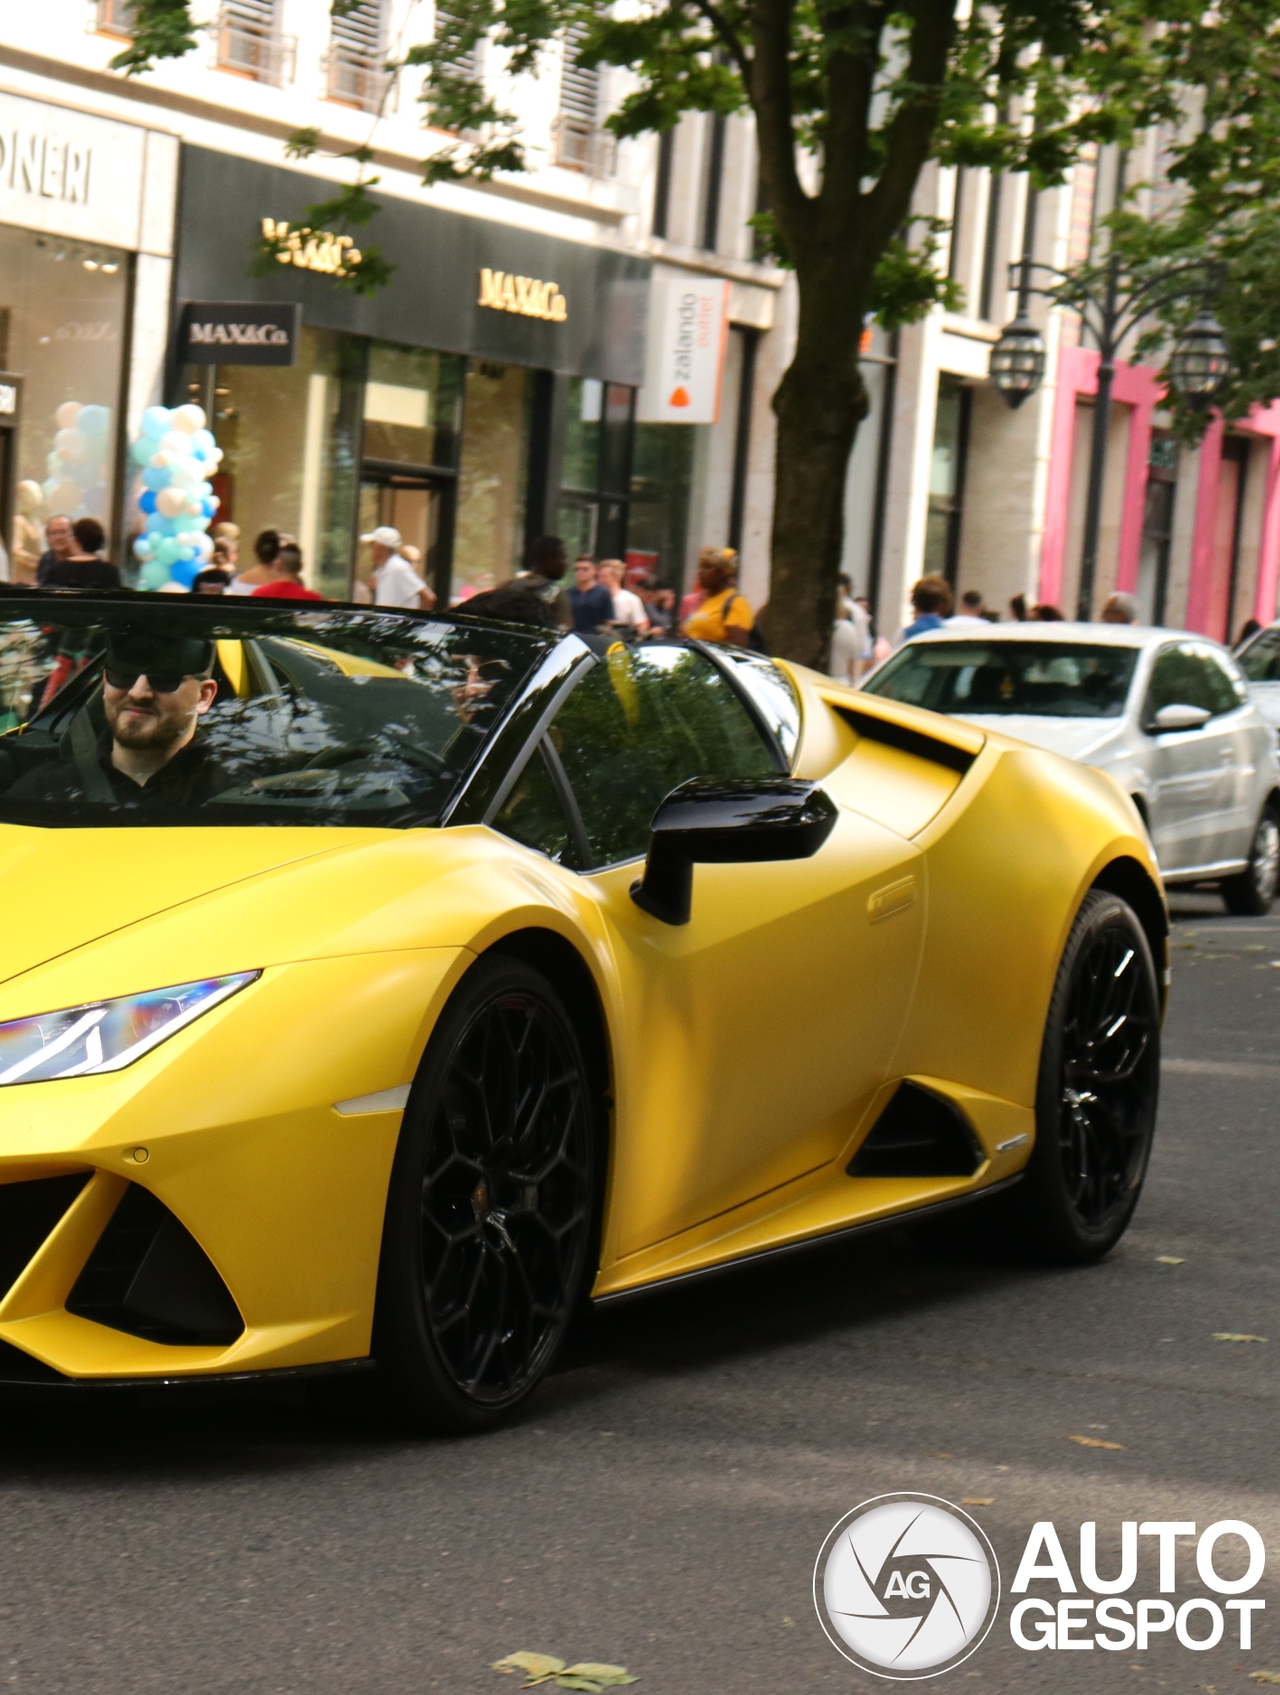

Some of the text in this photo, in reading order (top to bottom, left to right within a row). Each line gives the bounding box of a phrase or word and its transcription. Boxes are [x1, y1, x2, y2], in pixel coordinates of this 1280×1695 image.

[188, 322, 290, 345] MAX&Co.
[674, 293, 697, 381] zalando
[697, 296, 713, 348] outlet
